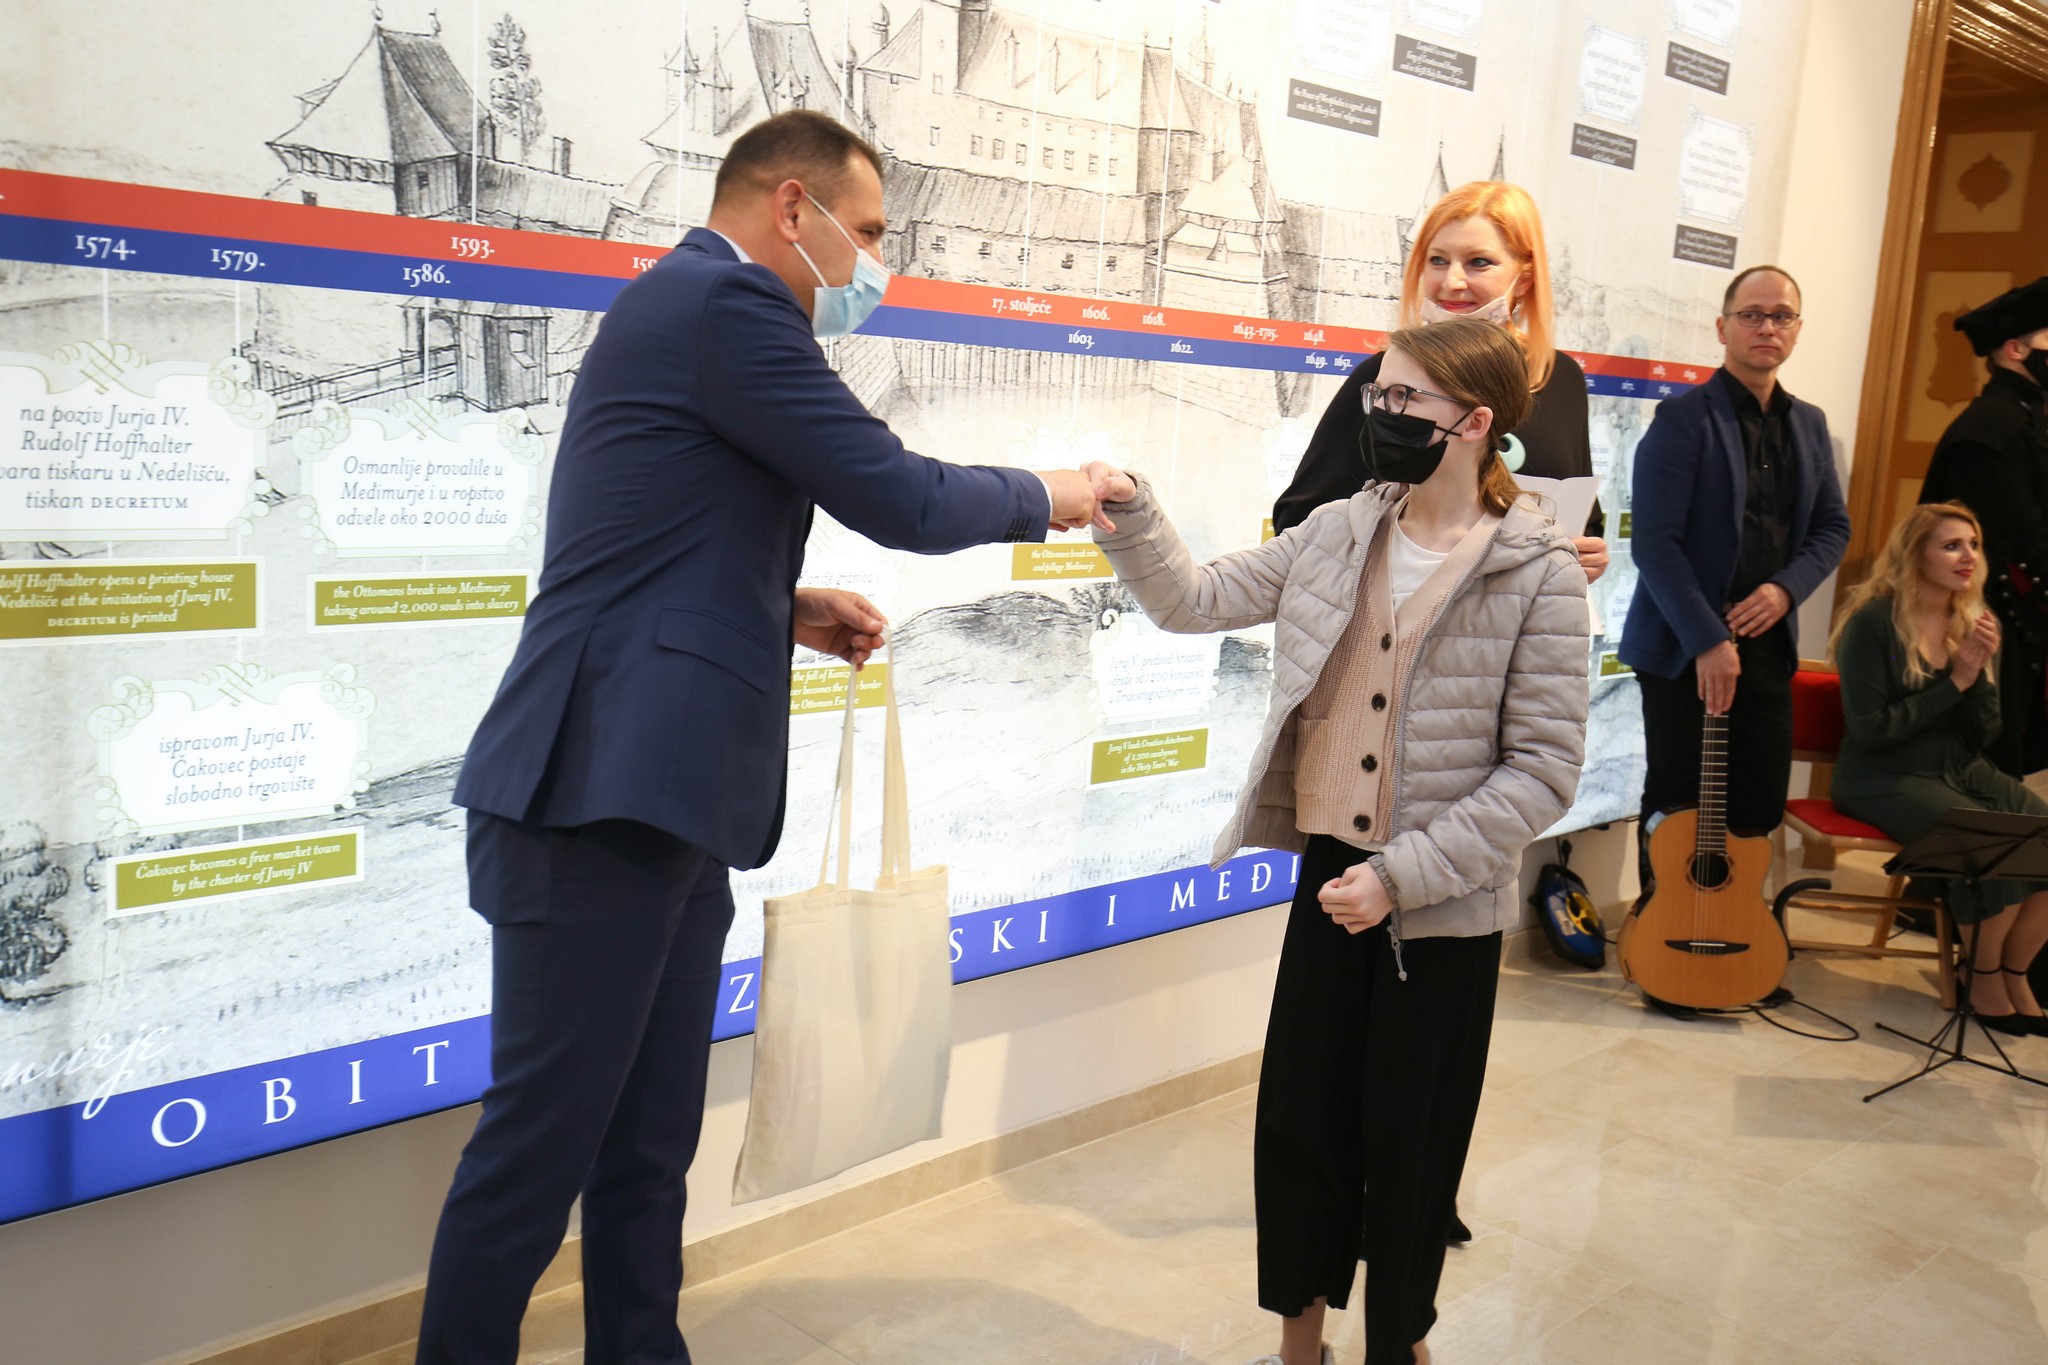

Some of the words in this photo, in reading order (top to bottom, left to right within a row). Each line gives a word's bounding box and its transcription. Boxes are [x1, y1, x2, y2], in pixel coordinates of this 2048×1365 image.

[75, 235, 137, 261] 1574.
[211, 248, 266, 273] 1579.
[450, 236, 495, 261] 1593.
[402, 264, 451, 289] 1586.
[992, 298, 1007, 314] 17.
[1009, 297, 1052, 317] stoljeće
[1082, 305, 1111, 321] 1606.
[1142, 312, 1166, 327] 1618.
[1068, 330, 1096, 350] 1603.
[1171, 340, 1194, 354] 1622.
[20, 408, 45, 422] na
[50, 406, 103, 430] poziv
[105, 405, 155, 432] Jurja
[162, 407, 189, 426] IV.
[21, 431, 92, 459] Rudolf
[94, 433, 193, 460] Hoffhalter
[0, 466, 41, 480] vara
[47, 461, 114, 481] tiskaru
[121, 469, 131, 481] u
[137, 462, 231, 484] Nedelišću,
[343, 456, 422, 482] Osmanlije
[425, 459, 491, 482] provalile
[495, 465, 504, 476] u
[26, 489, 84, 509] tiskan
[91, 497, 189, 509] DECRETUM
[341, 482, 425, 507] Međimurje
[430, 485, 435, 501] i
[439, 490, 448, 501] u
[452, 486, 505, 506] ropstvo
[337, 508, 385, 526] odvele
[390, 509, 418, 526] oko
[424, 511, 471, 526] 2000
[475, 510, 508, 525] duša
[26, 573, 97, 593] Hoffhalter
[98, 575, 135, 590] opens
[137, 577, 147, 587] a
[148, 572, 199, 589] printing
[200, 570, 235, 583] house
[333, 586, 350, 599] the
[353, 585, 406, 598] Ottomans
[407, 584, 436, 596] break
[437, 583, 458, 595] into
[458, 582, 512, 599] Međimurje
[61, 595, 76, 607] at
[78, 593, 98, 607] the
[101, 593, 163, 606] invitation
[165, 590, 182, 608] of
[178, 590, 213, 607] Juraj
[324, 604, 357, 620] taking
[359, 602, 398, 616] around
[440, 600, 465, 612] souls
[466, 600, 486, 611] into
[486, 598, 520, 613] slavery
[48, 617, 116, 628] DECRETUM
[120, 612, 131, 625] is
[131, 609, 179, 628] printed
[159, 734, 239, 760] ispravom
[241, 728, 286, 752] Jurja
[291, 723, 315, 743] IV.
[172, 756, 245, 779] Čakovec
[249, 753, 307, 777] postaje
[166, 785, 243, 806] slobodno
[248, 777, 317, 802] trgovište
[136, 862, 188, 880] Čakovec
[190, 857, 238, 873] becomes
[239, 857, 247, 866] a
[246, 851, 271, 869] free
[273, 846, 312, 862] market
[314, 843, 341, 854] town
[172, 880, 187, 897] by
[189, 877, 207, 891] the
[209, 872, 252, 888] charter
[253, 867, 268, 885] of
[265, 865, 296, 883] Juraj
[297, 861, 314, 876] IV
[151, 1040, 450, 1148] OBIT
[1106, 895, 1118, 927] I
[1169, 855, 1299, 913] MEĐI
